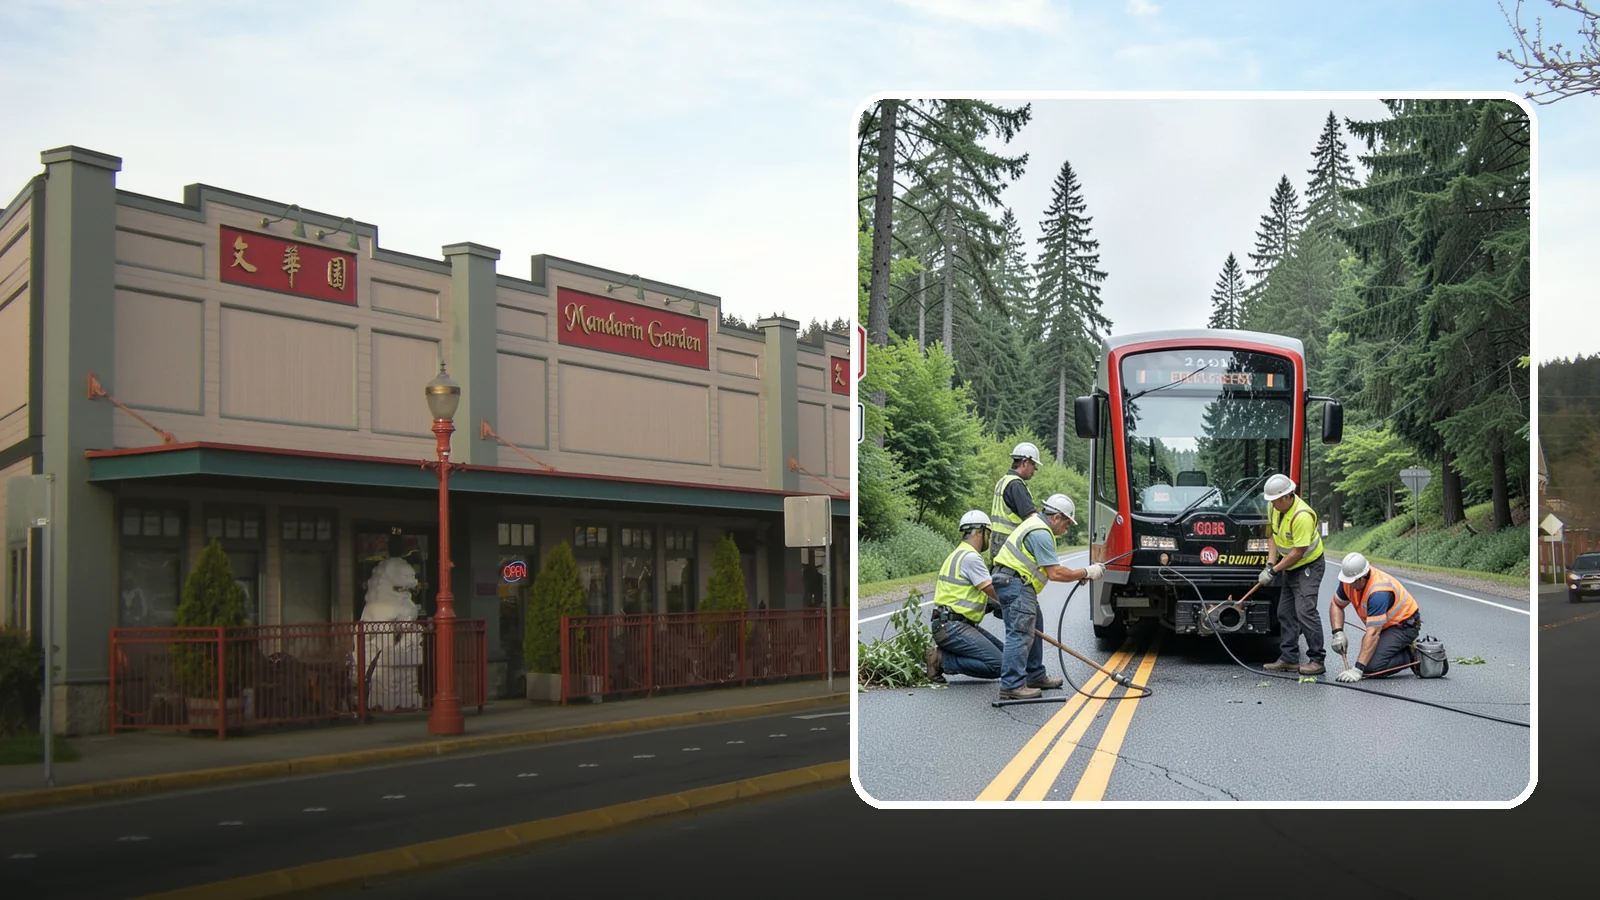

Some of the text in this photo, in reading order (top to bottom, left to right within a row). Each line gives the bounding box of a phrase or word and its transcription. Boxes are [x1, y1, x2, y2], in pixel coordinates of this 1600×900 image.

[230, 235, 346, 291] 文華園
[564, 302, 702, 352] Mandarin Garden
[503, 565, 527, 578] OPEN
